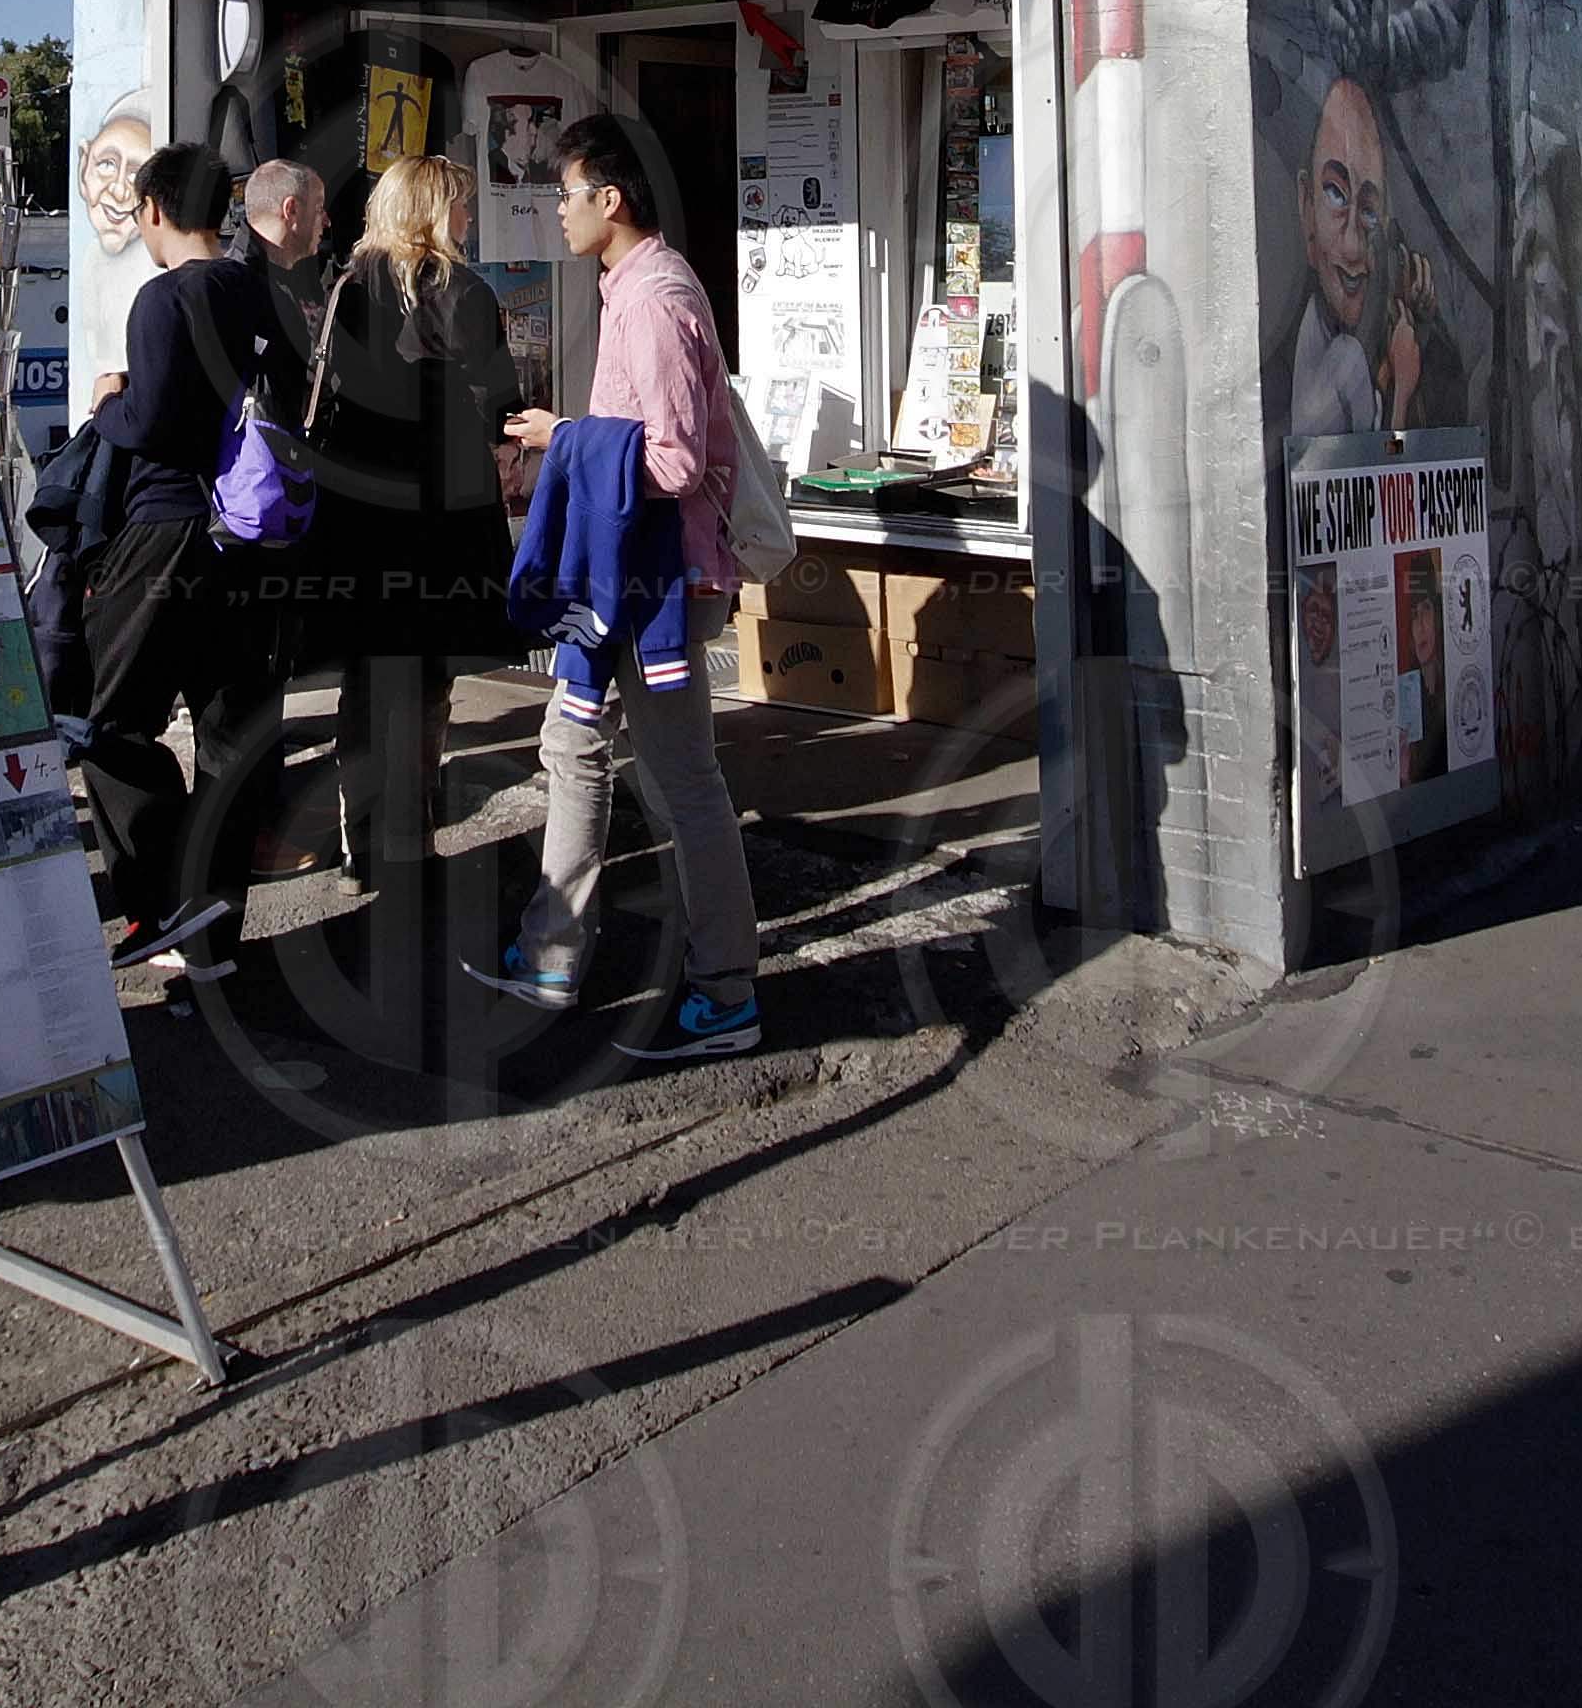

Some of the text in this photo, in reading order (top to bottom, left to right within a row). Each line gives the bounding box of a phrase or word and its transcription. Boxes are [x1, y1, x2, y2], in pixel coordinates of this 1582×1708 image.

[15, 360, 69, 391] HOS
[1295, 466, 1485, 557] WE STAMP YOUR PASSPORT
